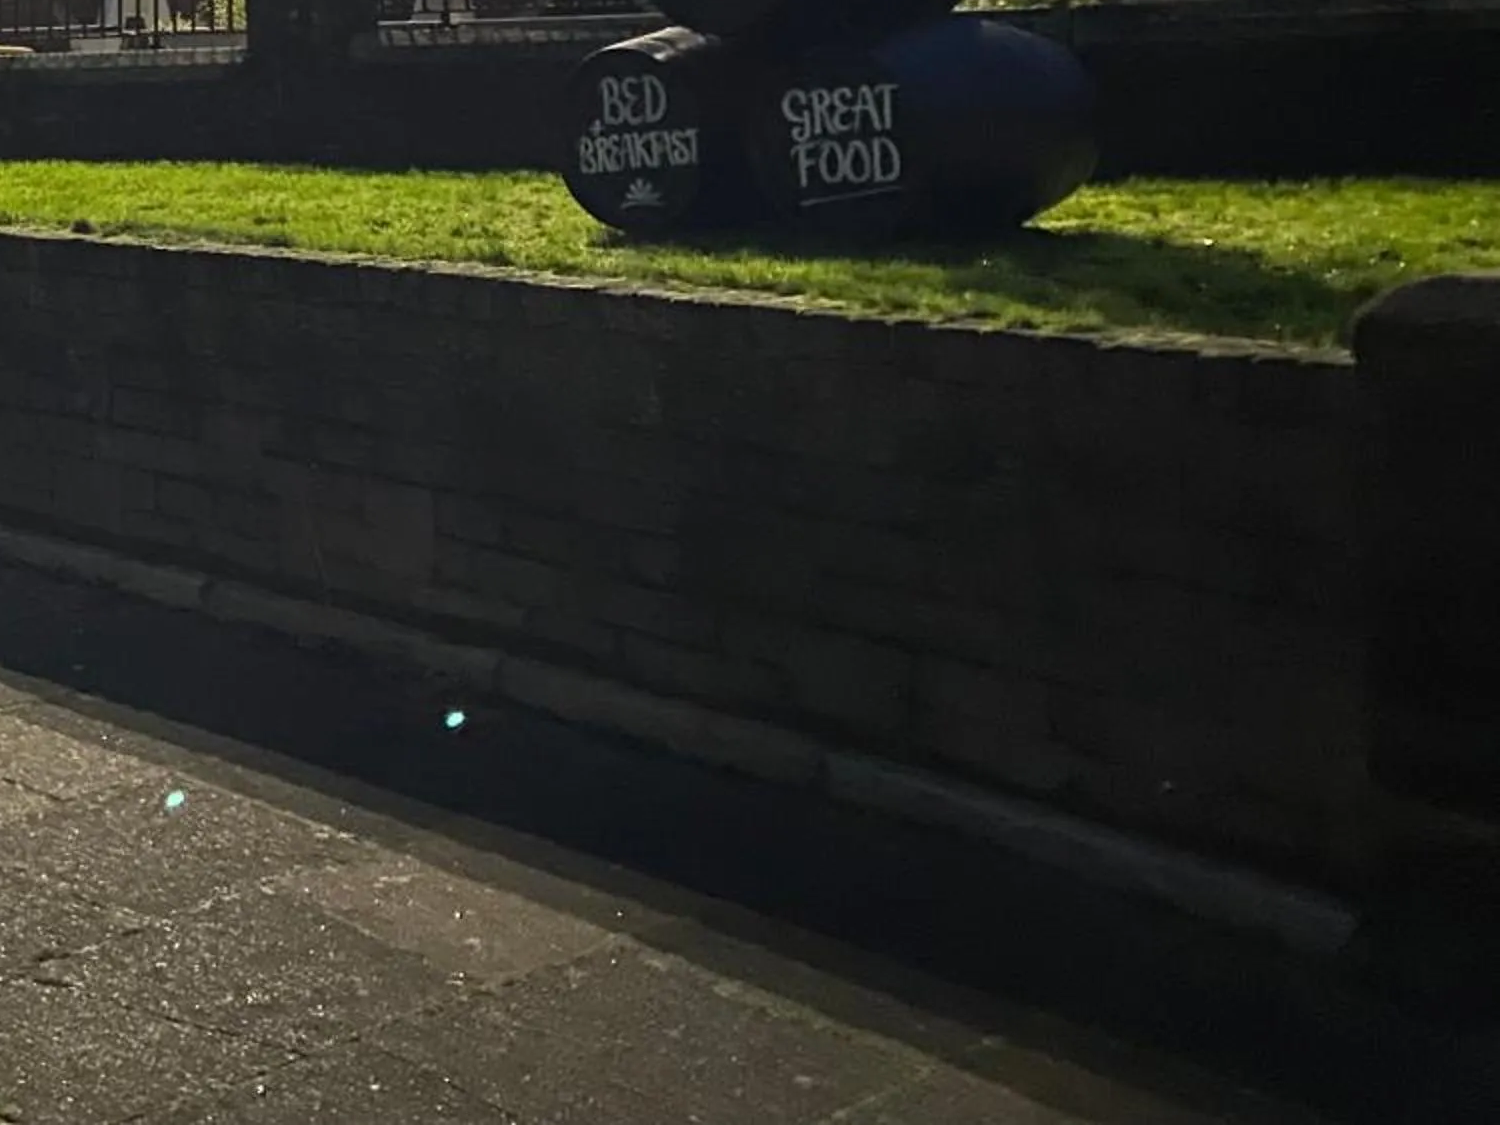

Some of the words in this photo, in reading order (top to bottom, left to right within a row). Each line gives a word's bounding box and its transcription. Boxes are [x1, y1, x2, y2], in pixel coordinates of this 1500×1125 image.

[601, 75, 667, 125] BED
[780, 83, 899, 142] GREAT
[579, 129, 699, 173] BREAKFAST
[790, 136, 901, 188] FOOD
